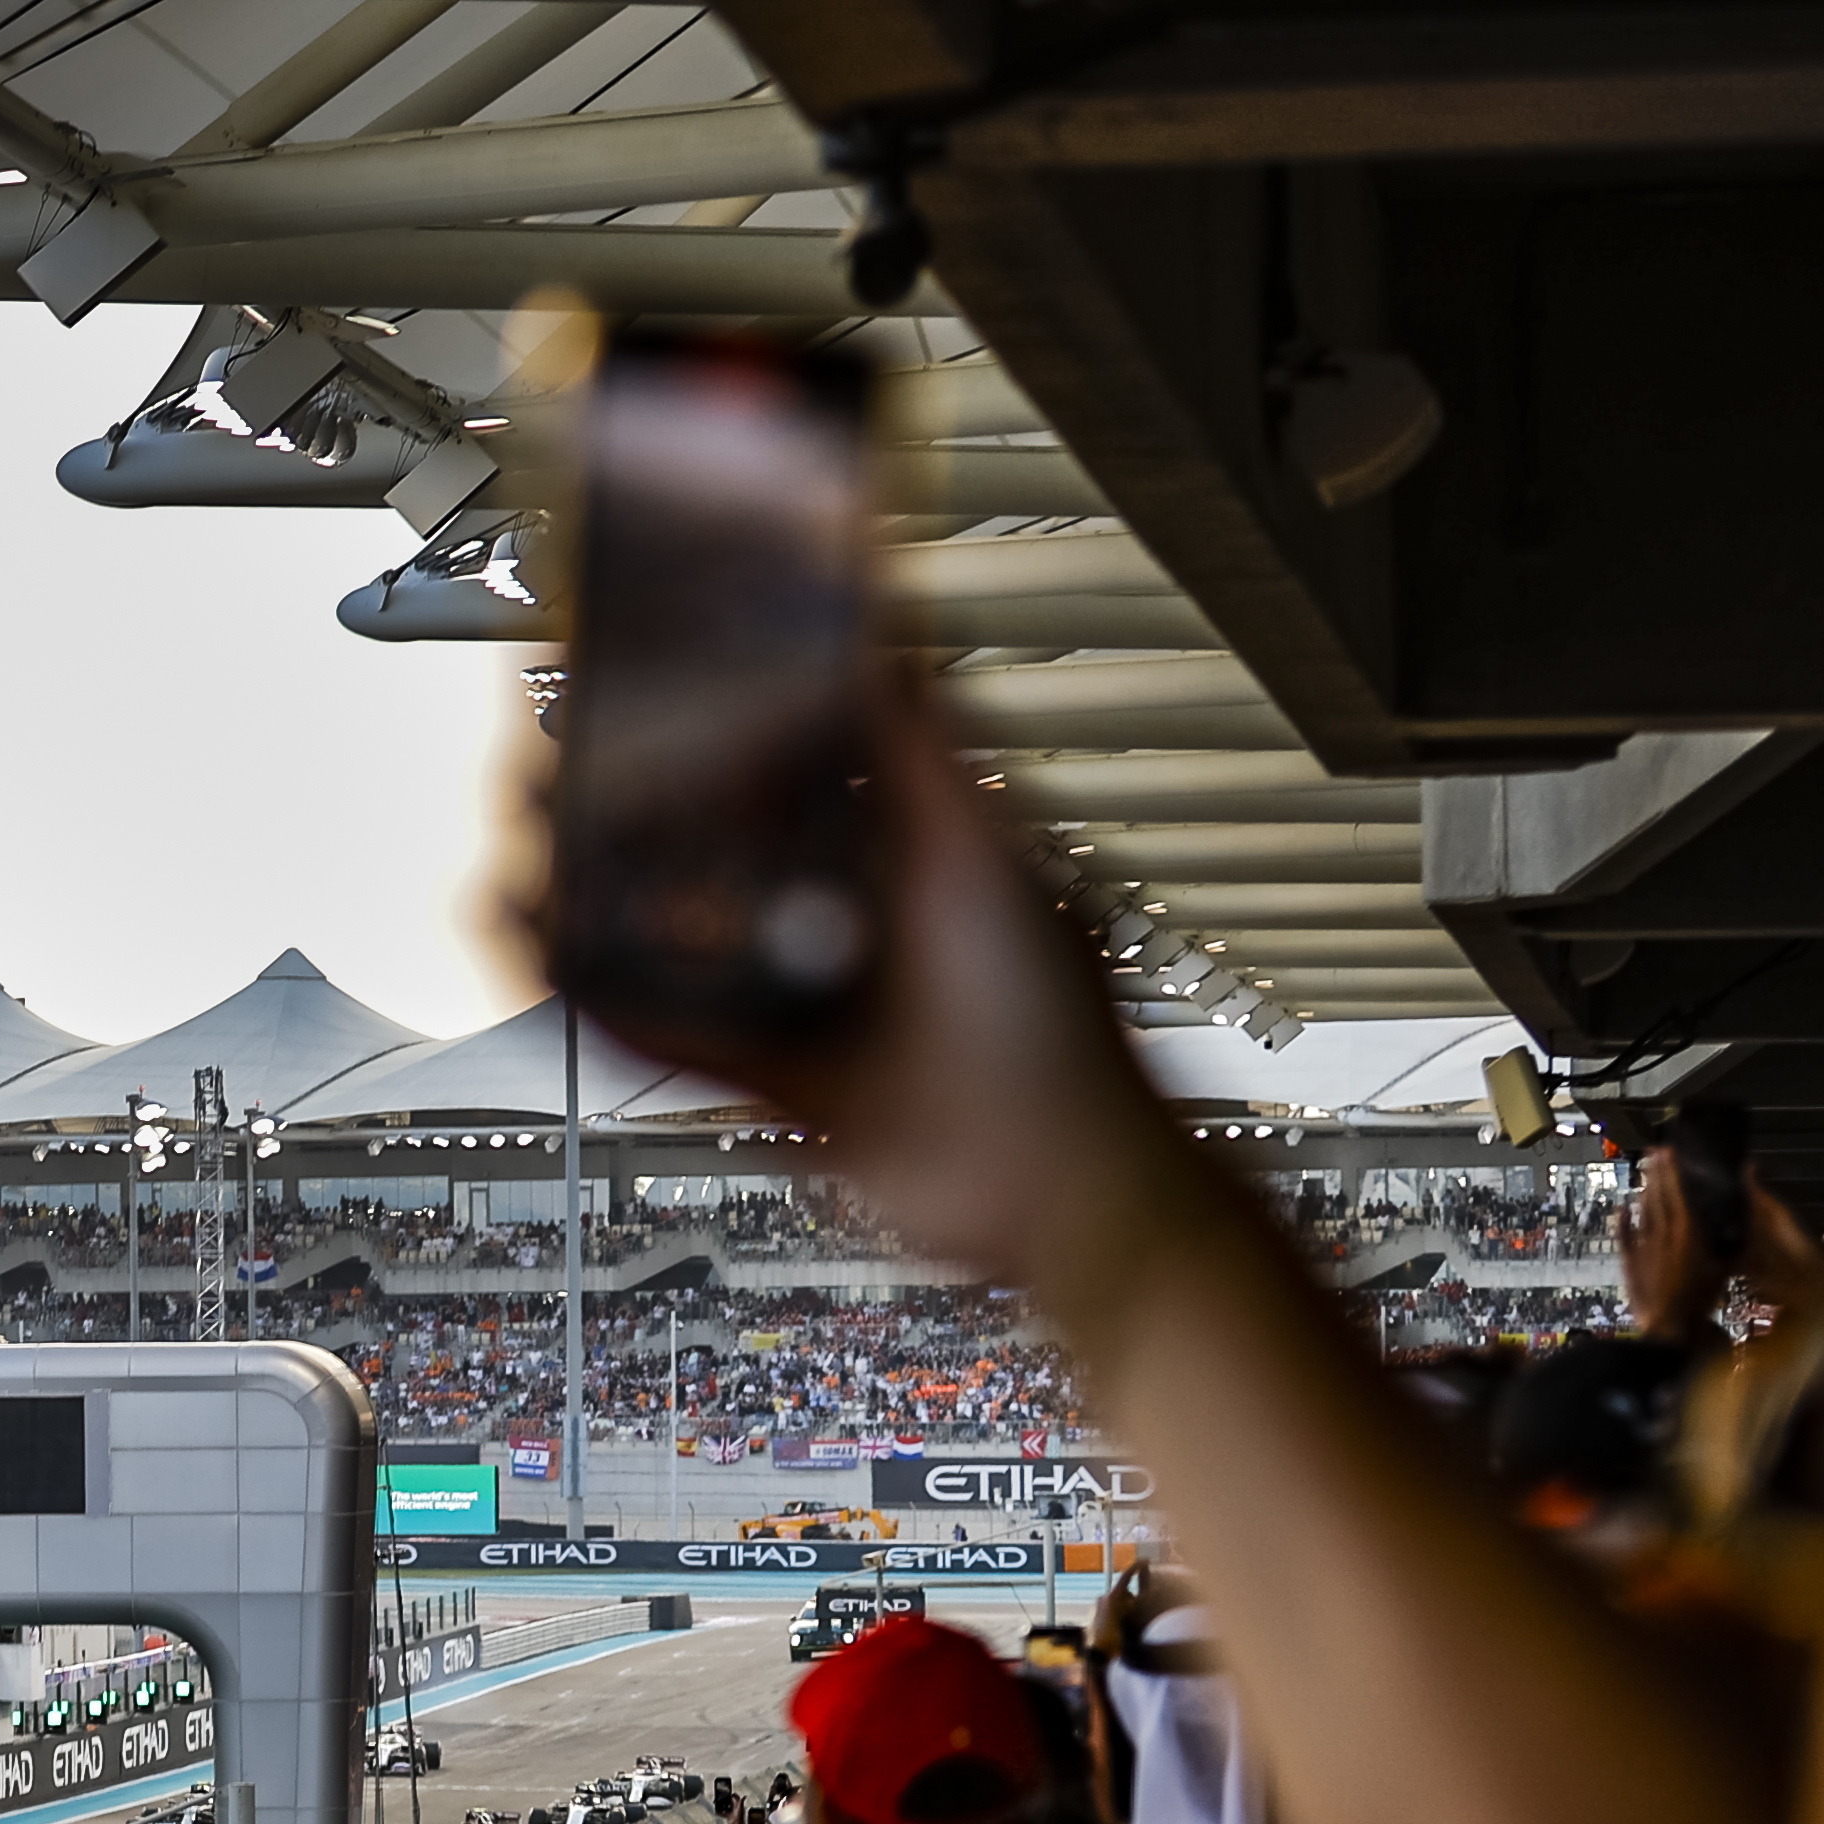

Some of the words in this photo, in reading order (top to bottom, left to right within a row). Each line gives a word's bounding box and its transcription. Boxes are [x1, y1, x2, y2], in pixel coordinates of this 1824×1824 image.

[924, 1464, 1155, 1502] ETIHAD
[412, 1491, 450, 1501] world's
[452, 1491, 478, 1501] most
[435, 1501, 471, 1511] engine
[480, 1542, 617, 1566] ETIHAD
[678, 1544, 818, 1569] ETIHAD
[885, 1546, 1028, 1569] ETIHAD
[185, 1707, 214, 1752] ETIH
[121, 1718, 169, 1770] ETIHAD
[53, 1735, 104, 1789] ETIHAD
